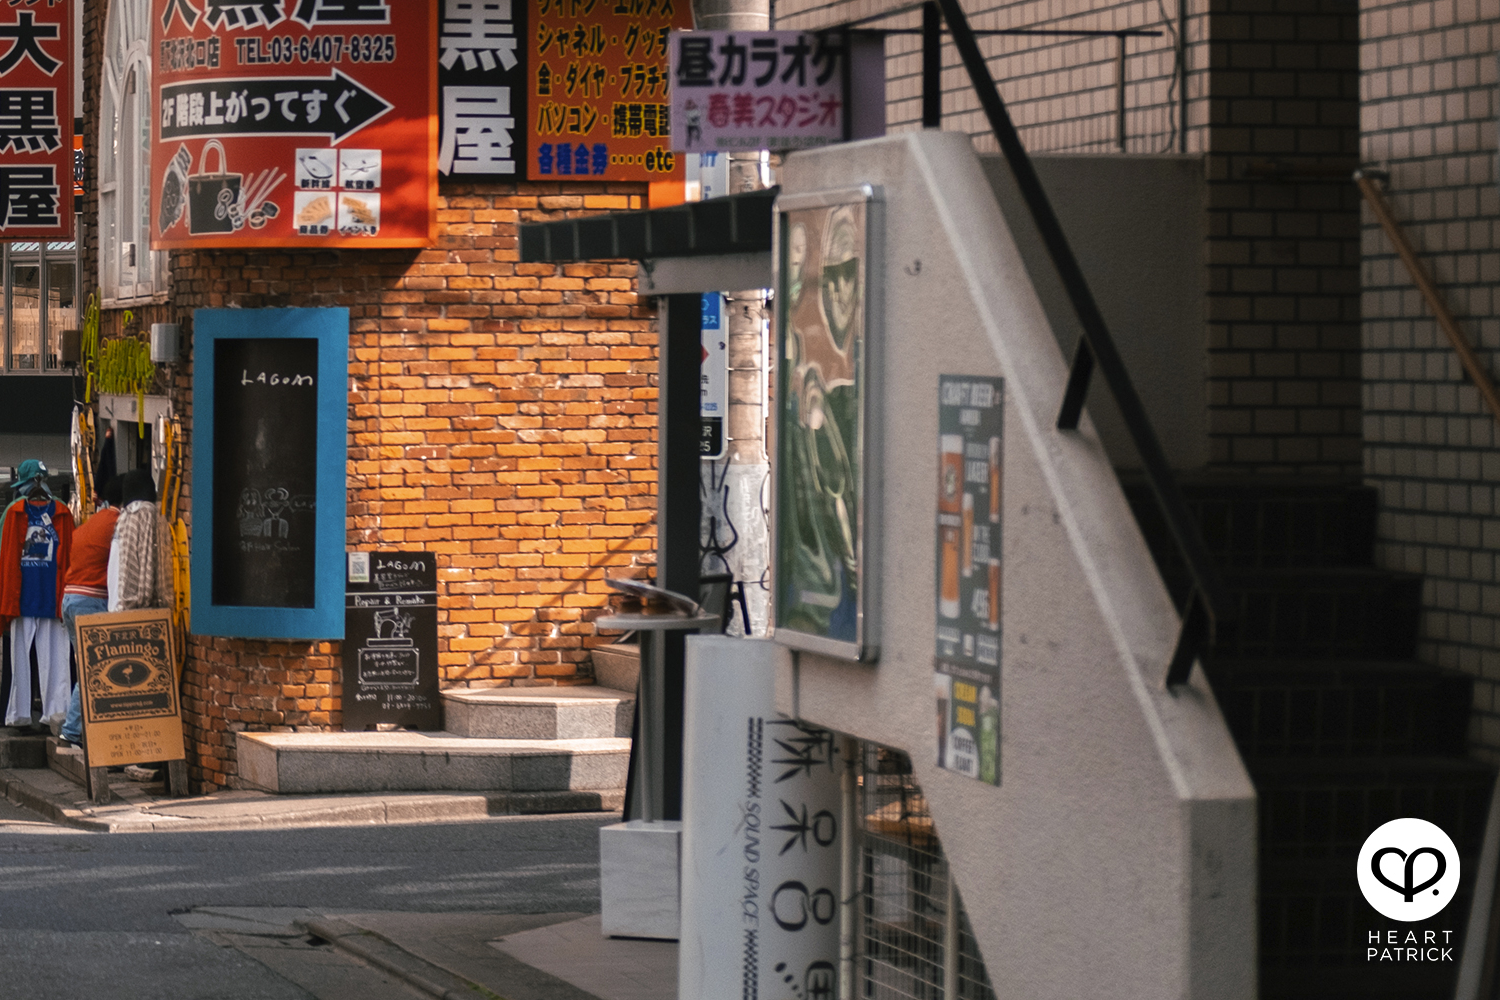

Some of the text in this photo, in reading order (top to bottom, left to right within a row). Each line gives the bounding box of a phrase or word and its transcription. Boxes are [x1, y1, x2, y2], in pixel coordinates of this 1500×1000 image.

[676, 35, 844, 87] 昼カラオケ
[241, 369, 313, 386] LAGOM
[93, 641, 160, 660] Flamingo
[742, 801, 761, 927] SOUND SPACE
